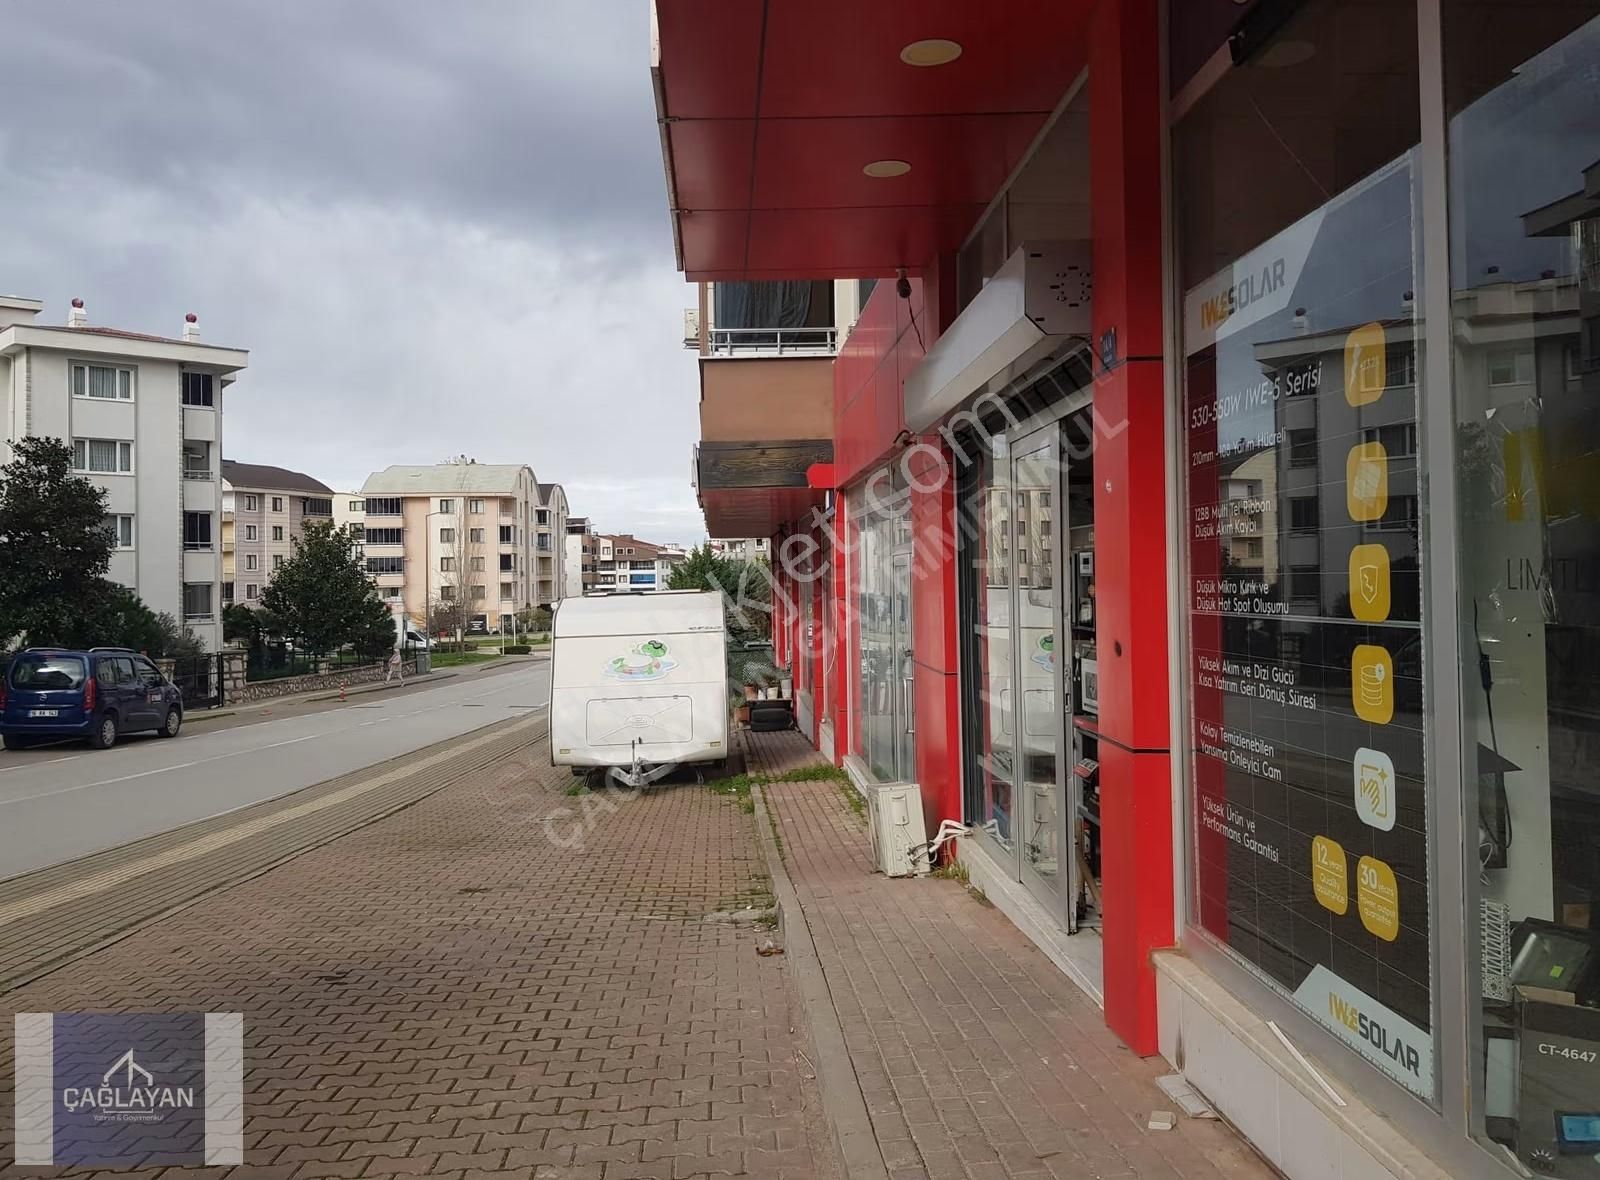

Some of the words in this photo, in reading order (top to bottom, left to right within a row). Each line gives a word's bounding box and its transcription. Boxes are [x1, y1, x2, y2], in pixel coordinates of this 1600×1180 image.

[1191, 391, 1242, 428] 530-550W
[1285, 361, 1322, 396] Serisi
[1256, 425, 1287, 449] Hücreli
[1243, 499, 1271, 514] Ribbon
[1195, 524, 1214, 540] Düşük
[1196, 580, 1216, 597] Düşük
[1217, 580, 1237, 594] Mikro
[1259, 583, 1269, 595] ve
[1196, 597, 1216, 614] Düşük
[1218, 599, 1231, 611] Hot
[1233, 597, 1251, 616] Spot
[1253, 598, 1290, 616] Oluşumu
[1198, 655, 1220, 672] Yüksek
[1222, 660, 1240, 676] Akım
[1242, 665, 1251, 678] ve
[1253, 664, 1269, 680] Dizi
[1271, 667, 1295, 686] Gücü
[1198, 672, 1213, 688] Kısa
[1213, 675, 1238, 693] Yatırım
[1240, 680, 1257, 697] Geri
[1259, 683, 1286, 707] Dönüş
[1288, 689, 1317, 710] Süresi
[1200, 721, 1219, 741] Kolay
[1220, 727, 1275, 758] Temizlenebilen
[1200, 739, 1228, 761] Yansıma
[1229, 747, 1260, 774] Önleyici
[1262, 761, 1282, 781] Cam
[1202, 795, 1225, 817] Yüksek
[1226, 803, 1244, 827] Ürün
[1246, 818, 1256, 833] ve
[1202, 812, 1241, 843] Performans
[1243, 833, 1279, 863] Garantisi
[1316, 842, 1329, 865] 12
[1360, 864, 1378, 890] 30
[1538, 1043, 1597, 1063] CT-4647
